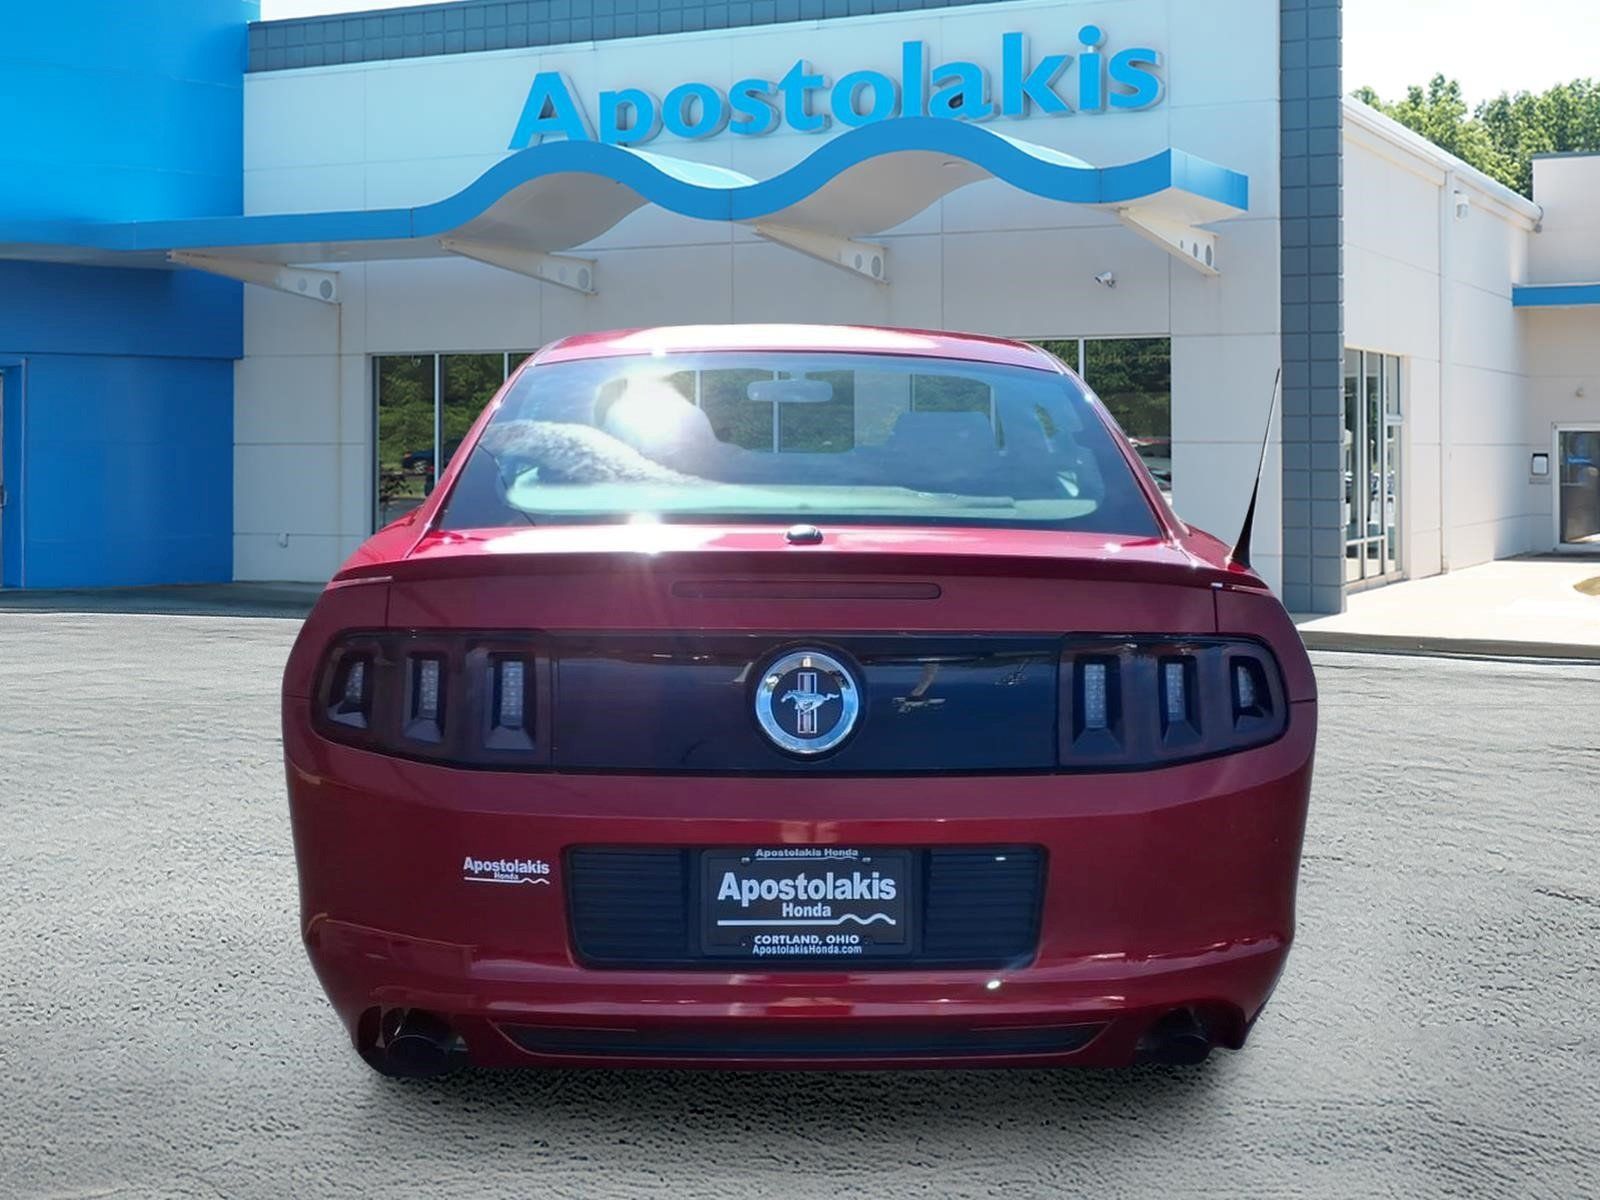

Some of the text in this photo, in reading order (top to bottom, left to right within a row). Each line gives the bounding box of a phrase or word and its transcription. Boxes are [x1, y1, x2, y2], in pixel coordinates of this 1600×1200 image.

[507, 25, 1163, 151] Apostolakis
[756, 848, 858, 857] Apostolakis Honda
[463, 857, 550, 874] Apostolakis
[717, 871, 897, 907] Apostolakis
[782, 903, 832, 917] Honda
[754, 935, 860, 945] CORTLAND, OHIO
[752, 944, 863, 956] ApostolakisHonda.com
